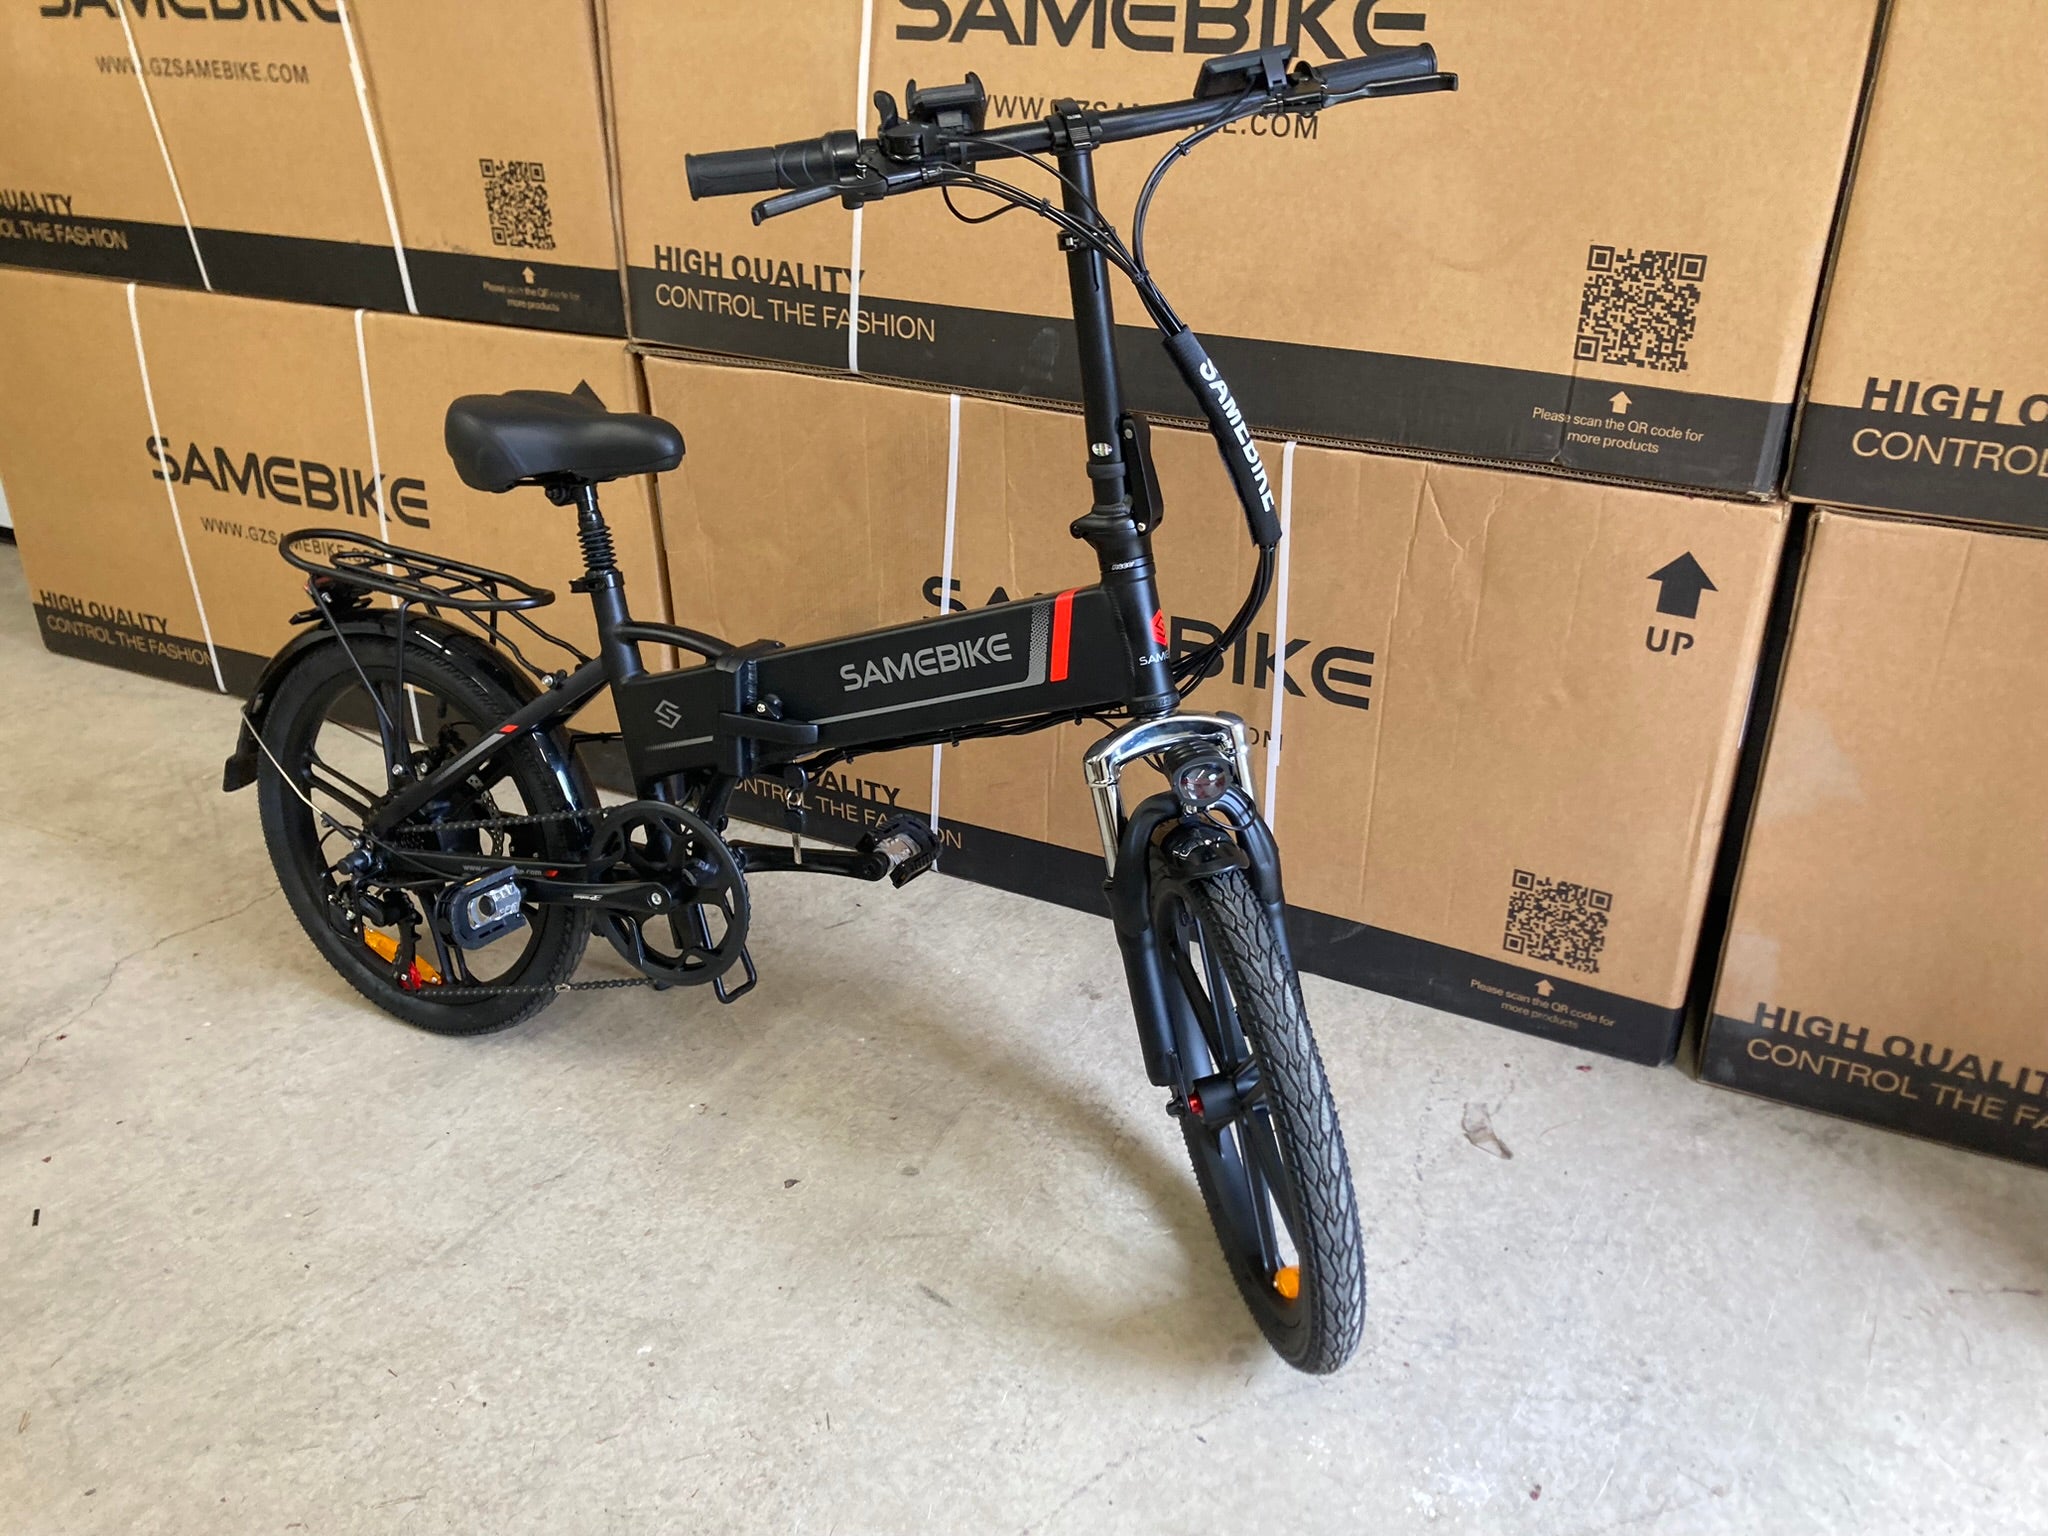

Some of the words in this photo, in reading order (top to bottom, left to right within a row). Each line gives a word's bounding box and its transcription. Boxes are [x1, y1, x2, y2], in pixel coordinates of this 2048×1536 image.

[0, 189, 72, 216] UALITY
[20, 220, 55, 243] THE
[54, 223, 129, 251] FASHION
[654, 244, 722, 279] HIGH
[655, 283, 764, 320] CONTROL
[768, 298, 817, 327] THE
[822, 306, 936, 342] FASHION
[1861, 376, 2004, 424] HIGH
[1200, 357, 1275, 513] SAMEBIKE
[1532, 406, 1570, 424] Please
[1573, 414, 1602, 428] scan
[1605, 418, 1625, 431] the
[1627, 420, 1648, 434] QR
[1650, 426, 1683, 440] code
[1685, 428, 1704, 442] for
[1567, 431, 1600, 445] more
[1602, 436, 1659, 454] products
[1852, 428, 2048, 478] CONTROL
[146, 435, 430, 529] SAMEBIKE
[39, 589, 84, 615] HIGH
[88, 601, 168, 635] QUALITY
[46, 614, 116, 645] CONTROL
[115, 631, 147, 653] THE
[839, 632, 1013, 691] SAMEBIKE
[1645, 625, 1695, 656] UP
[815, 795, 859, 823] THE
[1470, 978, 1504, 997] Please
[1505, 990, 1530, 1003] scan
[1532, 996, 1549, 1008] the
[1551, 1001, 1568, 1014] QR
[1570, 1008, 1597, 1023] code
[1599, 1015, 1616, 1027] for
[1501, 1002, 1530, 1016] more
[1531, 1010, 1578, 1029] products
[1752, 1002, 1870, 1053] HIGH
[1747, 1038, 1919, 1100] CONTROL
[1930, 1082, 2008, 1121] THE
